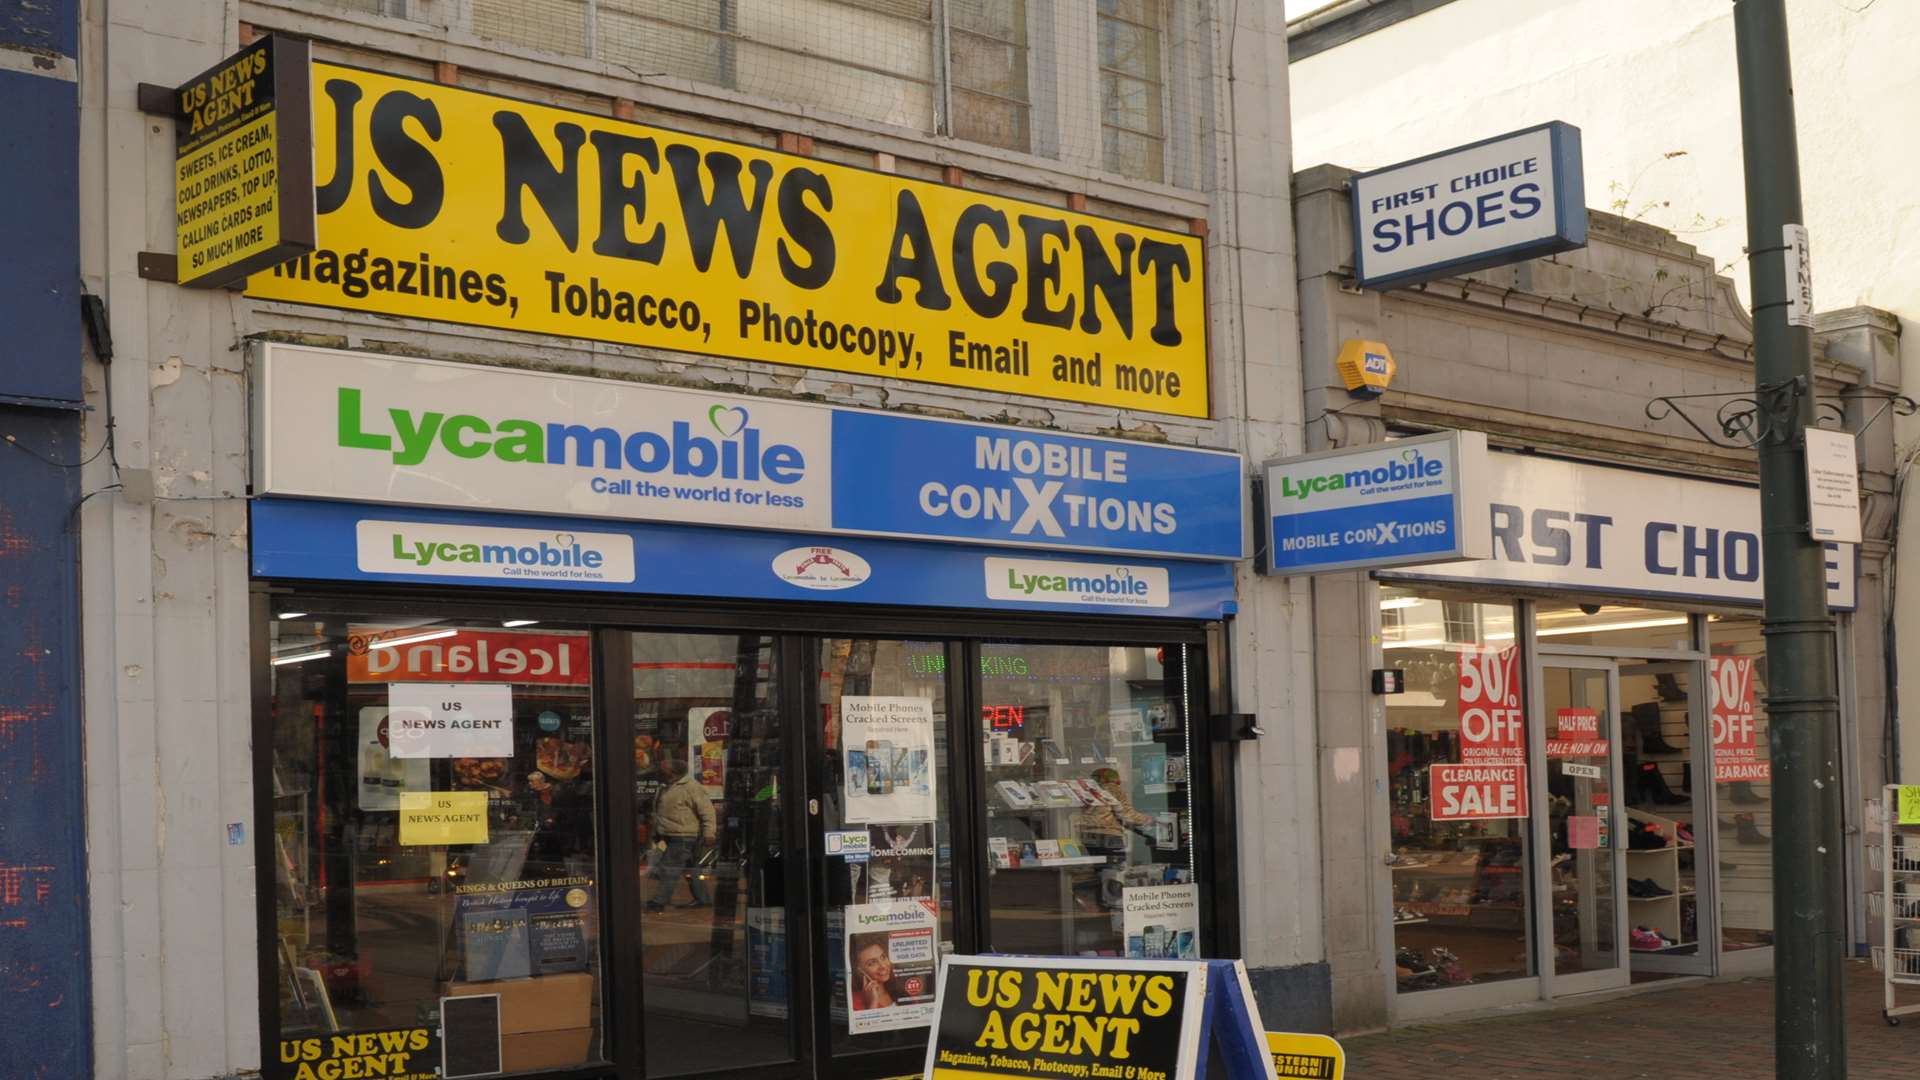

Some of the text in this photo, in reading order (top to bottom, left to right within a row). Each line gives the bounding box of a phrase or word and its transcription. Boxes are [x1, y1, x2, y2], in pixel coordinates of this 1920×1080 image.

[182, 82, 206, 113] US
[211, 48, 267, 99] NEWS
[190, 79, 256, 136] AGENT
[180, 152, 217, 181] SWEETS,
[218, 142, 234, 162] ICE
[235, 124, 272, 153] CREAM,
[179, 182, 202, 204] COLD
[204, 164, 241, 191] DRINKS,
[241, 176, 259, 198] TOP
[1372, 157, 1537, 214] FIRST CHOICE
[182, 196, 273, 249] CALLING CARDS and
[491, 110, 837, 290] NEWS
[875, 188, 1191, 347] AGENT
[1372, 182, 1541, 253] SHOES
[192, 225, 263, 268] SO MUCH MORE
[544, 270, 711, 342] Tobacco,
[739, 299, 923, 370] Photocopy,
[948, 330, 1030, 377] Email
[1052, 352, 1101, 387] and
[1115, 362, 1181, 398] more
[1365, 356, 1386, 371] ADT
[337, 386, 806, 484] Lycamobile
[975, 436, 1127, 482] MOBILE
[1282, 455, 1443, 499] Lycamobile
[1390, 483, 1412, 492] world
[591, 475, 804, 508] Call the world for less
[1283, 532, 1339, 551] MOBILE
[1489, 503, 1613, 570] RST
[393, 533, 604, 568] Lycamobile
[502, 566, 604, 580] Call the world for less
[1008, 567, 1148, 595] Lycamobile
[1461, 645, 1517, 708] 50%
[441, 702, 462, 711] US
[846, 714, 928, 724] Cracked Screens
[849, 703, 924, 713] Mobile Phones
[982, 705, 1025, 727] PEN
[402, 719, 502, 729] NEWS AGENT
[1462, 708, 1522, 742] OFF
[1558, 715, 1597, 731] HALF PRICE
[1463, 747, 1523, 756] ORIGINAL PRICE
[1546, 743, 1607, 753] SALE NOW ON
[1442, 769, 1515, 782] CLEARANCE
[1569, 766, 1594, 775] OPEN
[1714, 765, 1769, 779] LEARANCE
[438, 800, 452, 808] US
[1442, 784, 1517, 815] SALE
[408, 813, 480, 823] NEWS AGENT
[843, 834, 867, 843] Lyca
[456, 876, 588, 894] KINGS & QUEENS OF BRITAIN
[1129, 891, 1191, 901] Mobile Phones
[858, 910, 925, 924] Lycamobile
[1127, 901, 1193, 911] Cracked Screens
[966, 969, 1175, 1017] US NEWS
[280, 1028, 430, 1063] US NEWS
[975, 1010, 1140, 1059] AGENT
[293, 1052, 411, 1080] AGENT
[940, 1050, 1166, 1080] Magazines, Tobacco, Photocopy, Email & More
[1272, 1055, 1319, 1067] STERN
[1276, 1065, 1318, 1076] UNION
